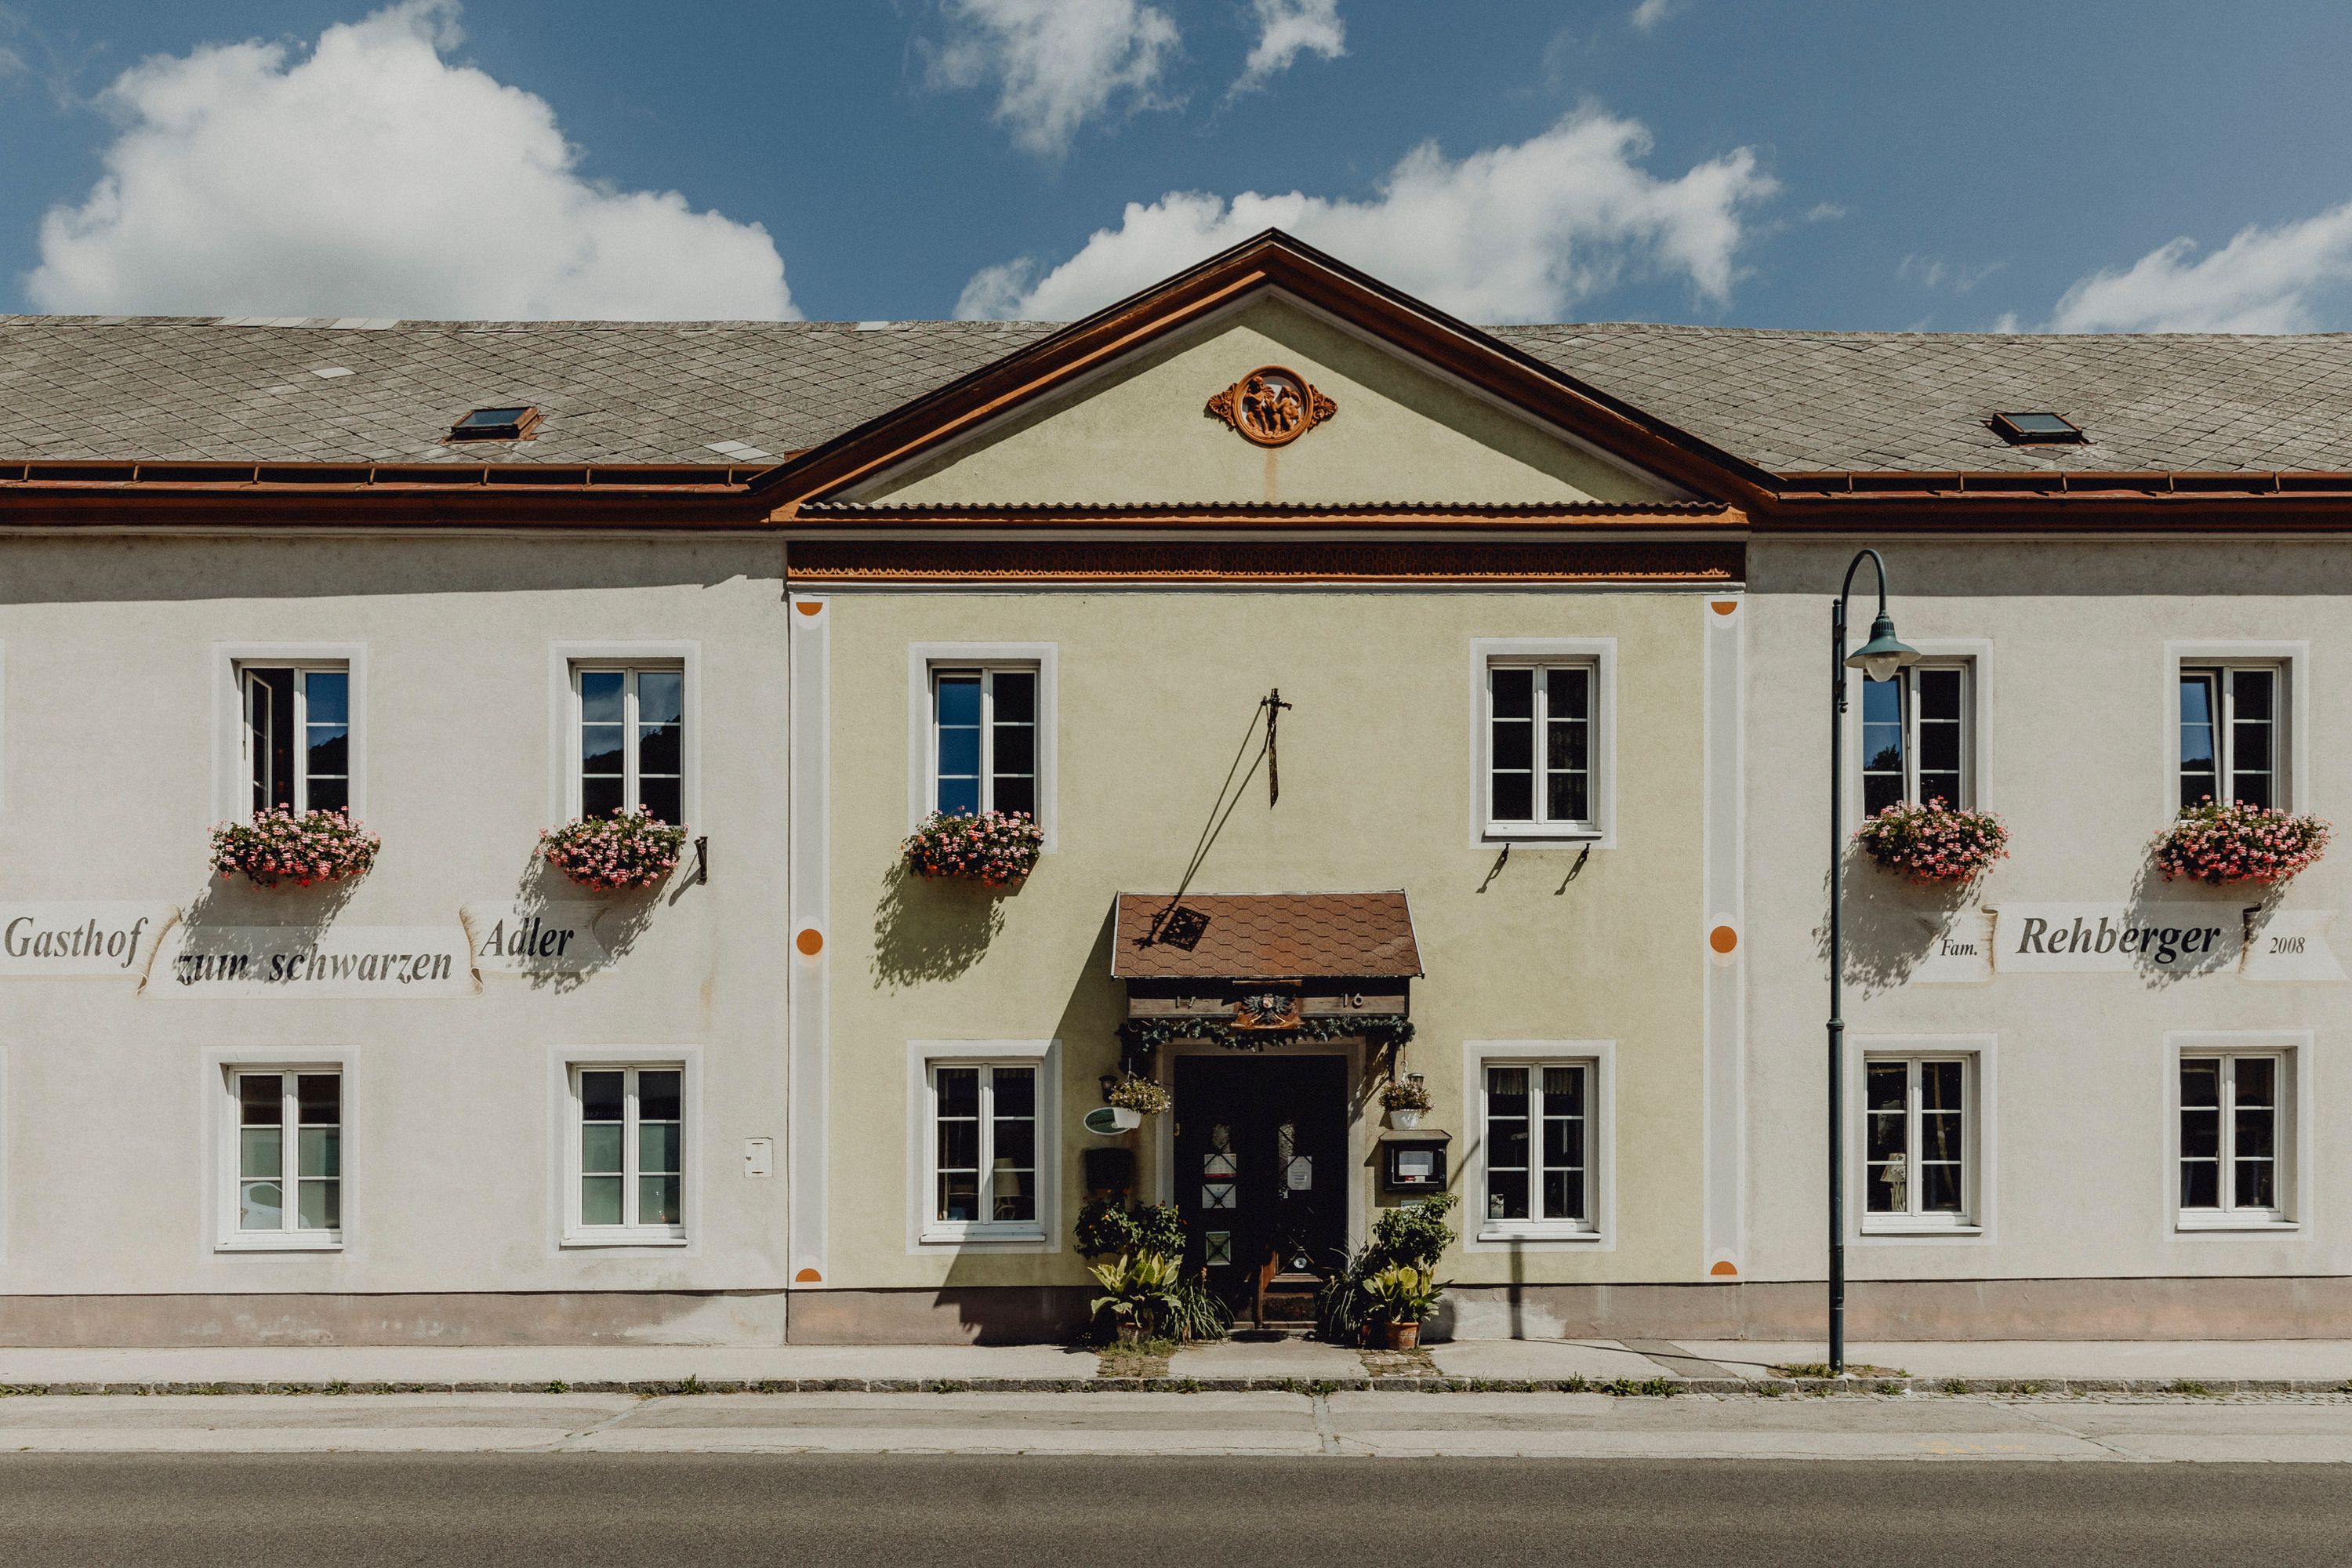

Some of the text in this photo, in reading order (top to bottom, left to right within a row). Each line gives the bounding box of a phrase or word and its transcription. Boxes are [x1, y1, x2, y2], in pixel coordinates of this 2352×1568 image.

[4, 916, 575, 985] Gasthof zum schwarzen Adler
[1940, 916, 2306, 964] Fam. Rehberger 2008
[1341, 993, 1364, 1007] 16
